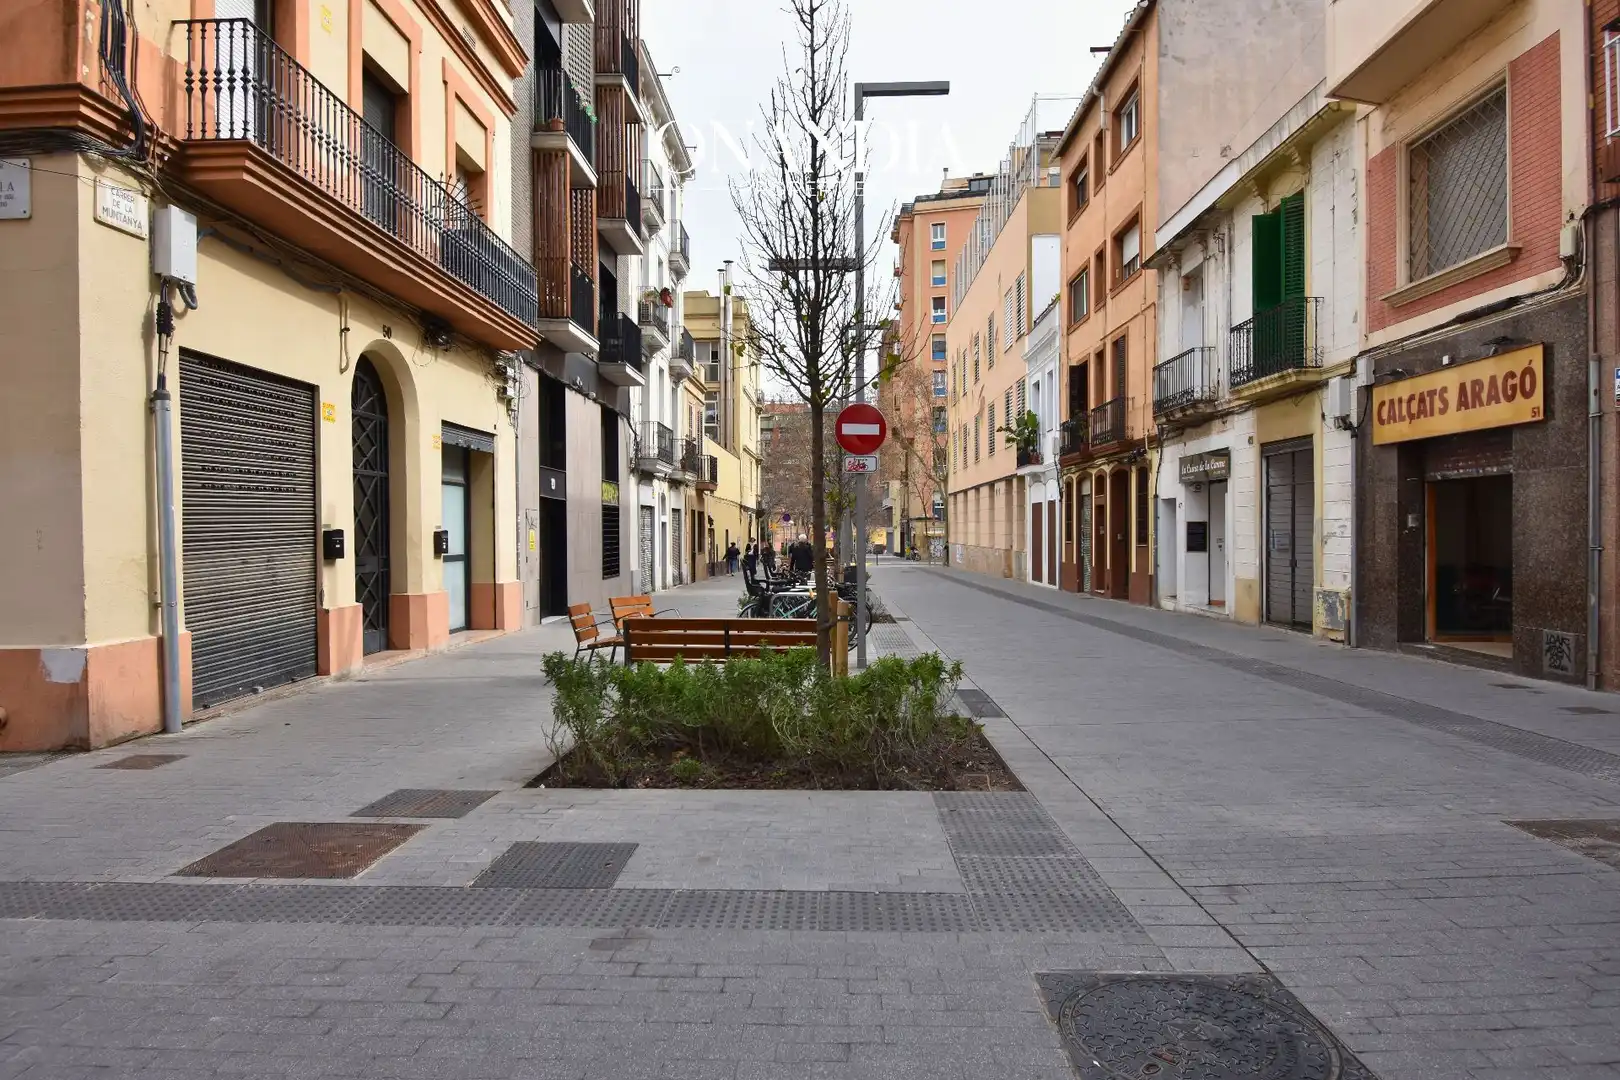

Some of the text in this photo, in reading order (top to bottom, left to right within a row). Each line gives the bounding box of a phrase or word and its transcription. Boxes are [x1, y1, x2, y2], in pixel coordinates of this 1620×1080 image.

[110, 187, 135, 203] CARRER
[112, 199, 133, 214] DE LA
[102, 206, 143, 230] MUNTANYA
[1377, 359, 1537, 426] CALÇATS ARAGÓ
[1531, 406, 1541, 418] 51
